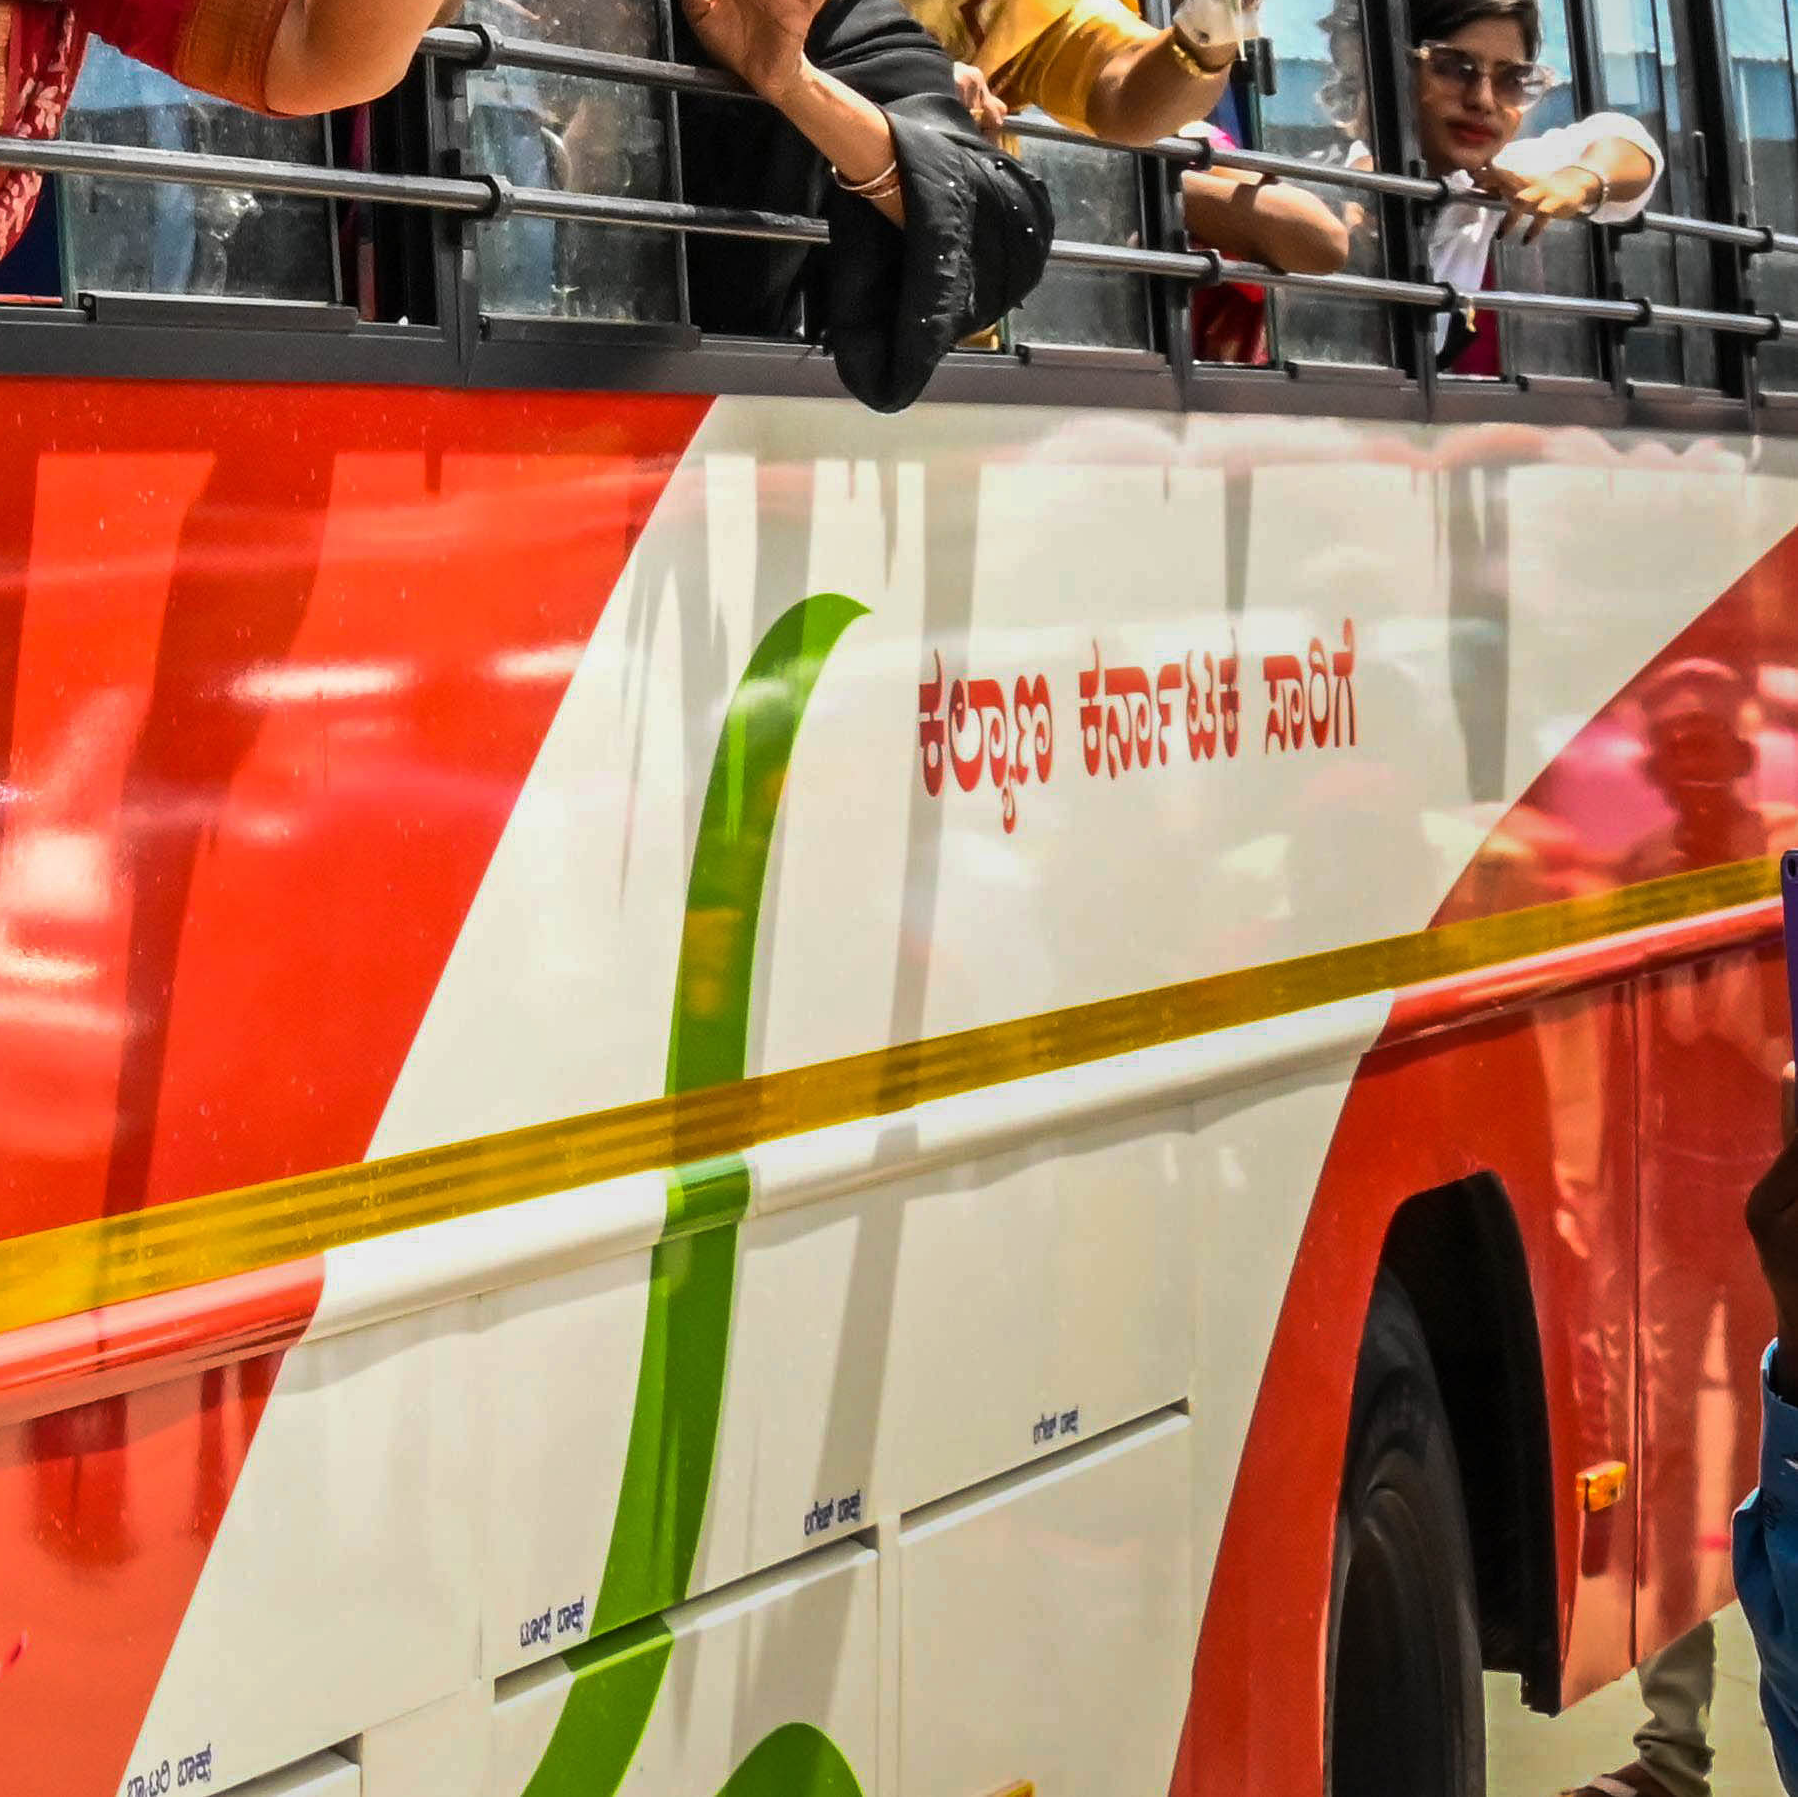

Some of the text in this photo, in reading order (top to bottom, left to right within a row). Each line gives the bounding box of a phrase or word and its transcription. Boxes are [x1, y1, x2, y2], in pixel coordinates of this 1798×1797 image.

[918, 617, 1357, 834] ಕಲ್ಯಾಣ ಕರ್ನಾಟಕ ಸಾರಿಗೆ
